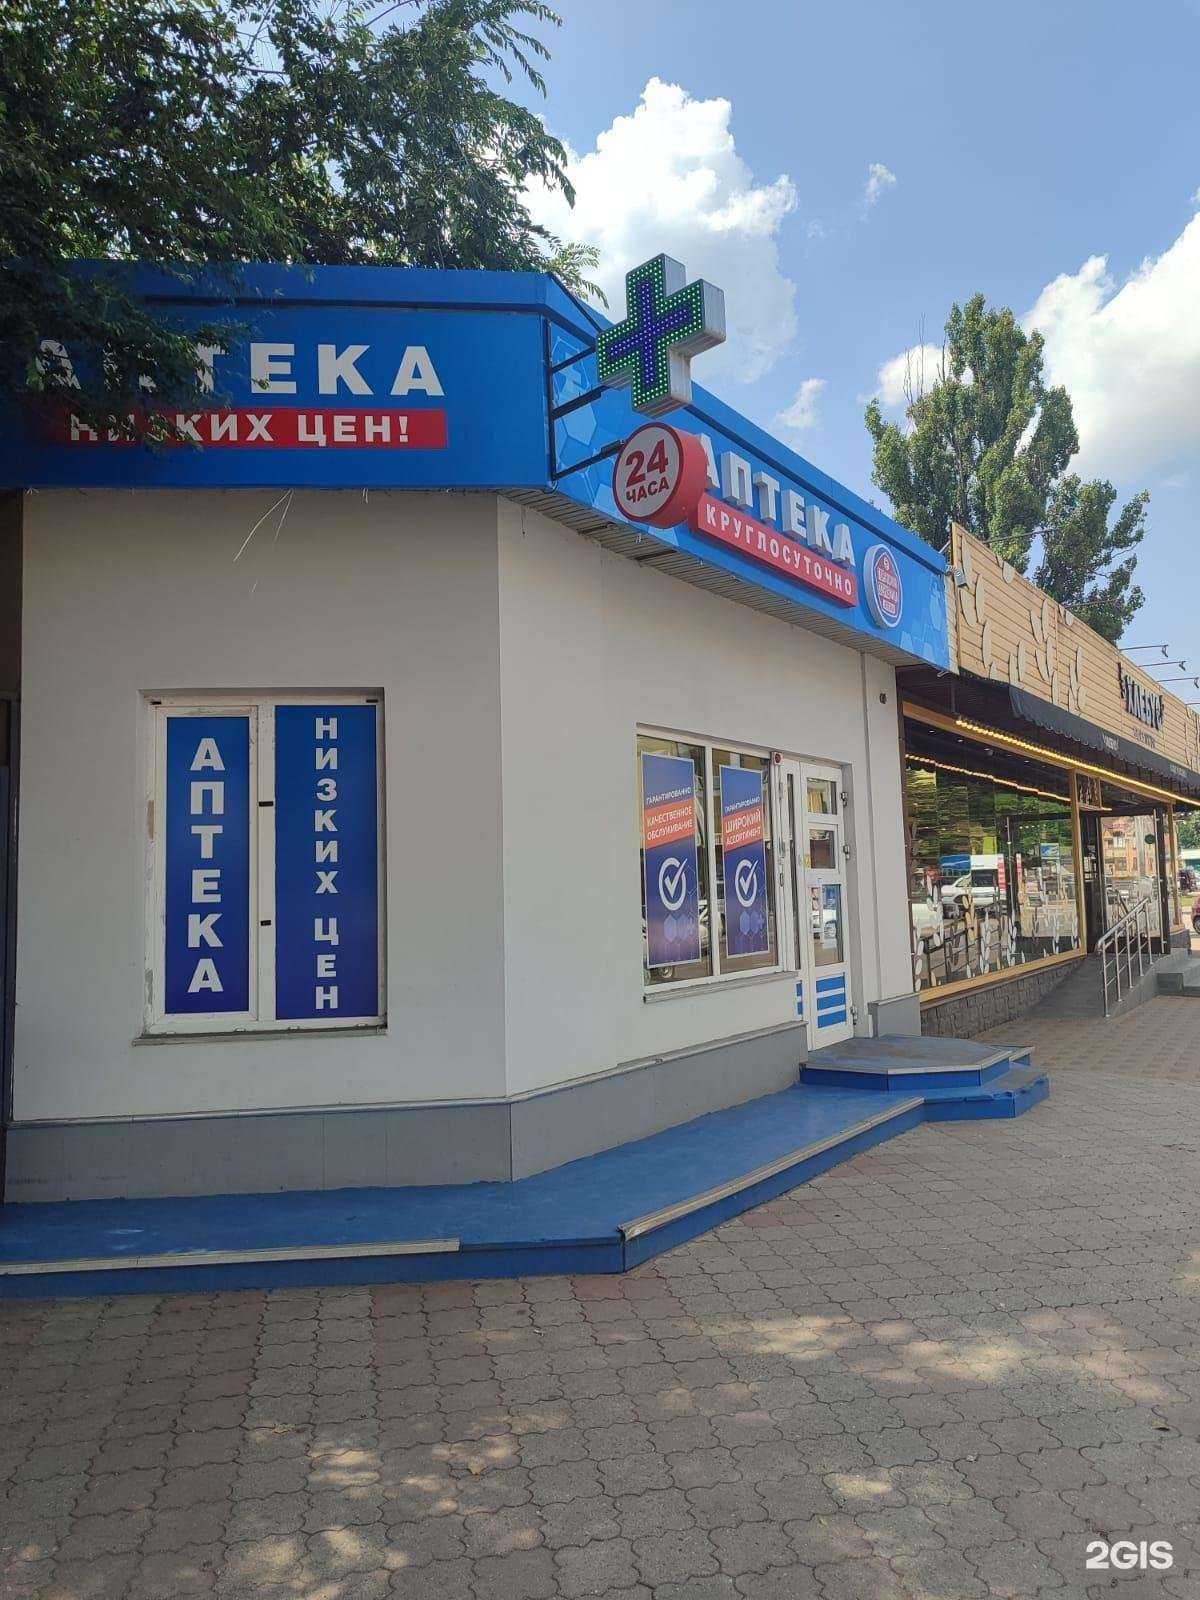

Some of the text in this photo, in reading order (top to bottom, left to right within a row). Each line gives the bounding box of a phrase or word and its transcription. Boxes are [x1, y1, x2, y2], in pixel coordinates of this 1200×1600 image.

[28, 339, 445, 397] АТЕКА
[70, 413, 408, 447] НКИХ ЦЕН!
[625, 438, 669, 488] 24
[626, 476, 670, 503] ЧАСА
[705, 502, 853, 597] КРУГЛОСУТОЧНО
[647, 805, 693, 828] КАЧЕСТВЕННОЕ
[647, 818, 693, 841] ОБСЛУЖИВАНИЕ
[725, 808, 761, 834] ШИРОКИЙ
[726, 826, 761, 846] АССОРТИМЕНТ
[187, 737, 226, 994] АПТЕКА
[314, 717, 339, 1010] НИЗКИХ ЦЕН
